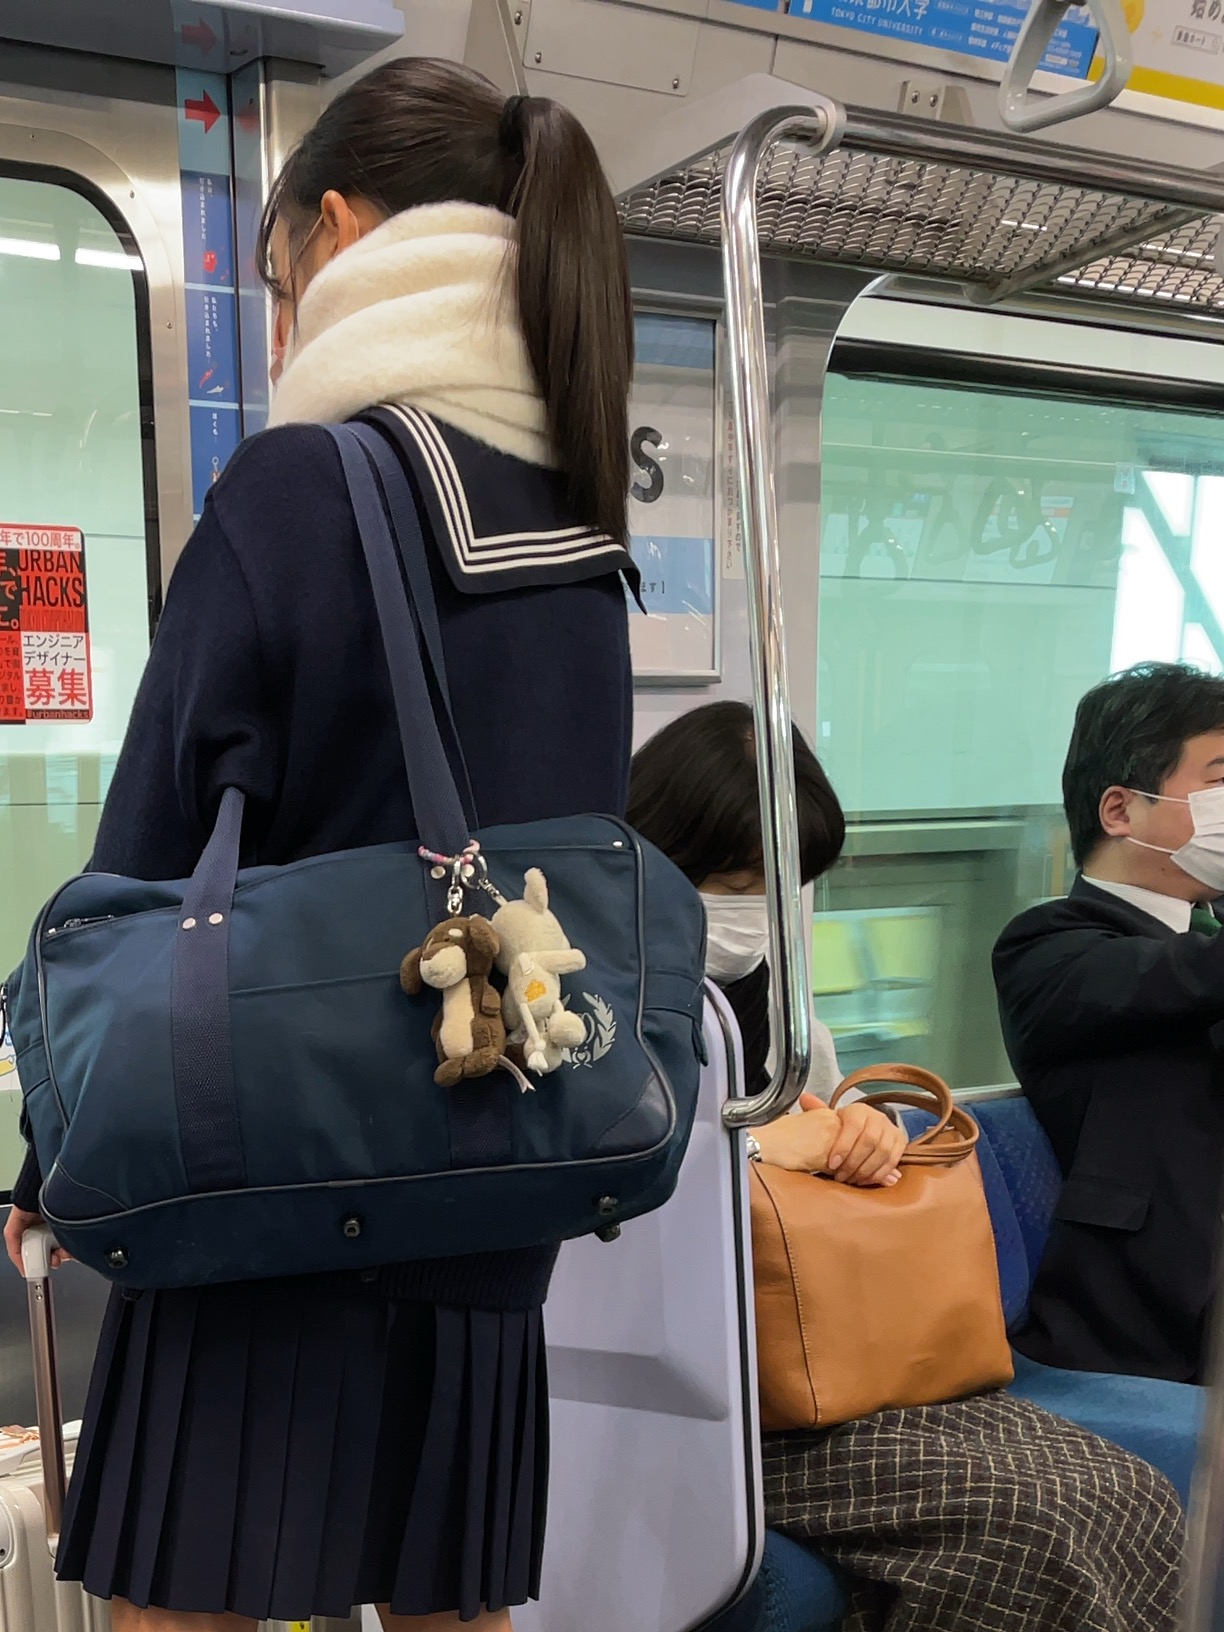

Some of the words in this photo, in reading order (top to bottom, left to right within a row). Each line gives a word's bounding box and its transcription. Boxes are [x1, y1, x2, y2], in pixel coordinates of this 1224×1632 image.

[831, 6, 855, 21] TOKYO
[857, 12, 877, 25] CITY
[878, 18, 923, 35] UNIVERSITY
[19, 549, 82, 574] URBAN
[20, 575, 85, 608] HACKS
[23, 634, 84, 649] エンジニア
[23, 650, 86, 666] デザイナー
[25, 667, 87, 706] 募集
